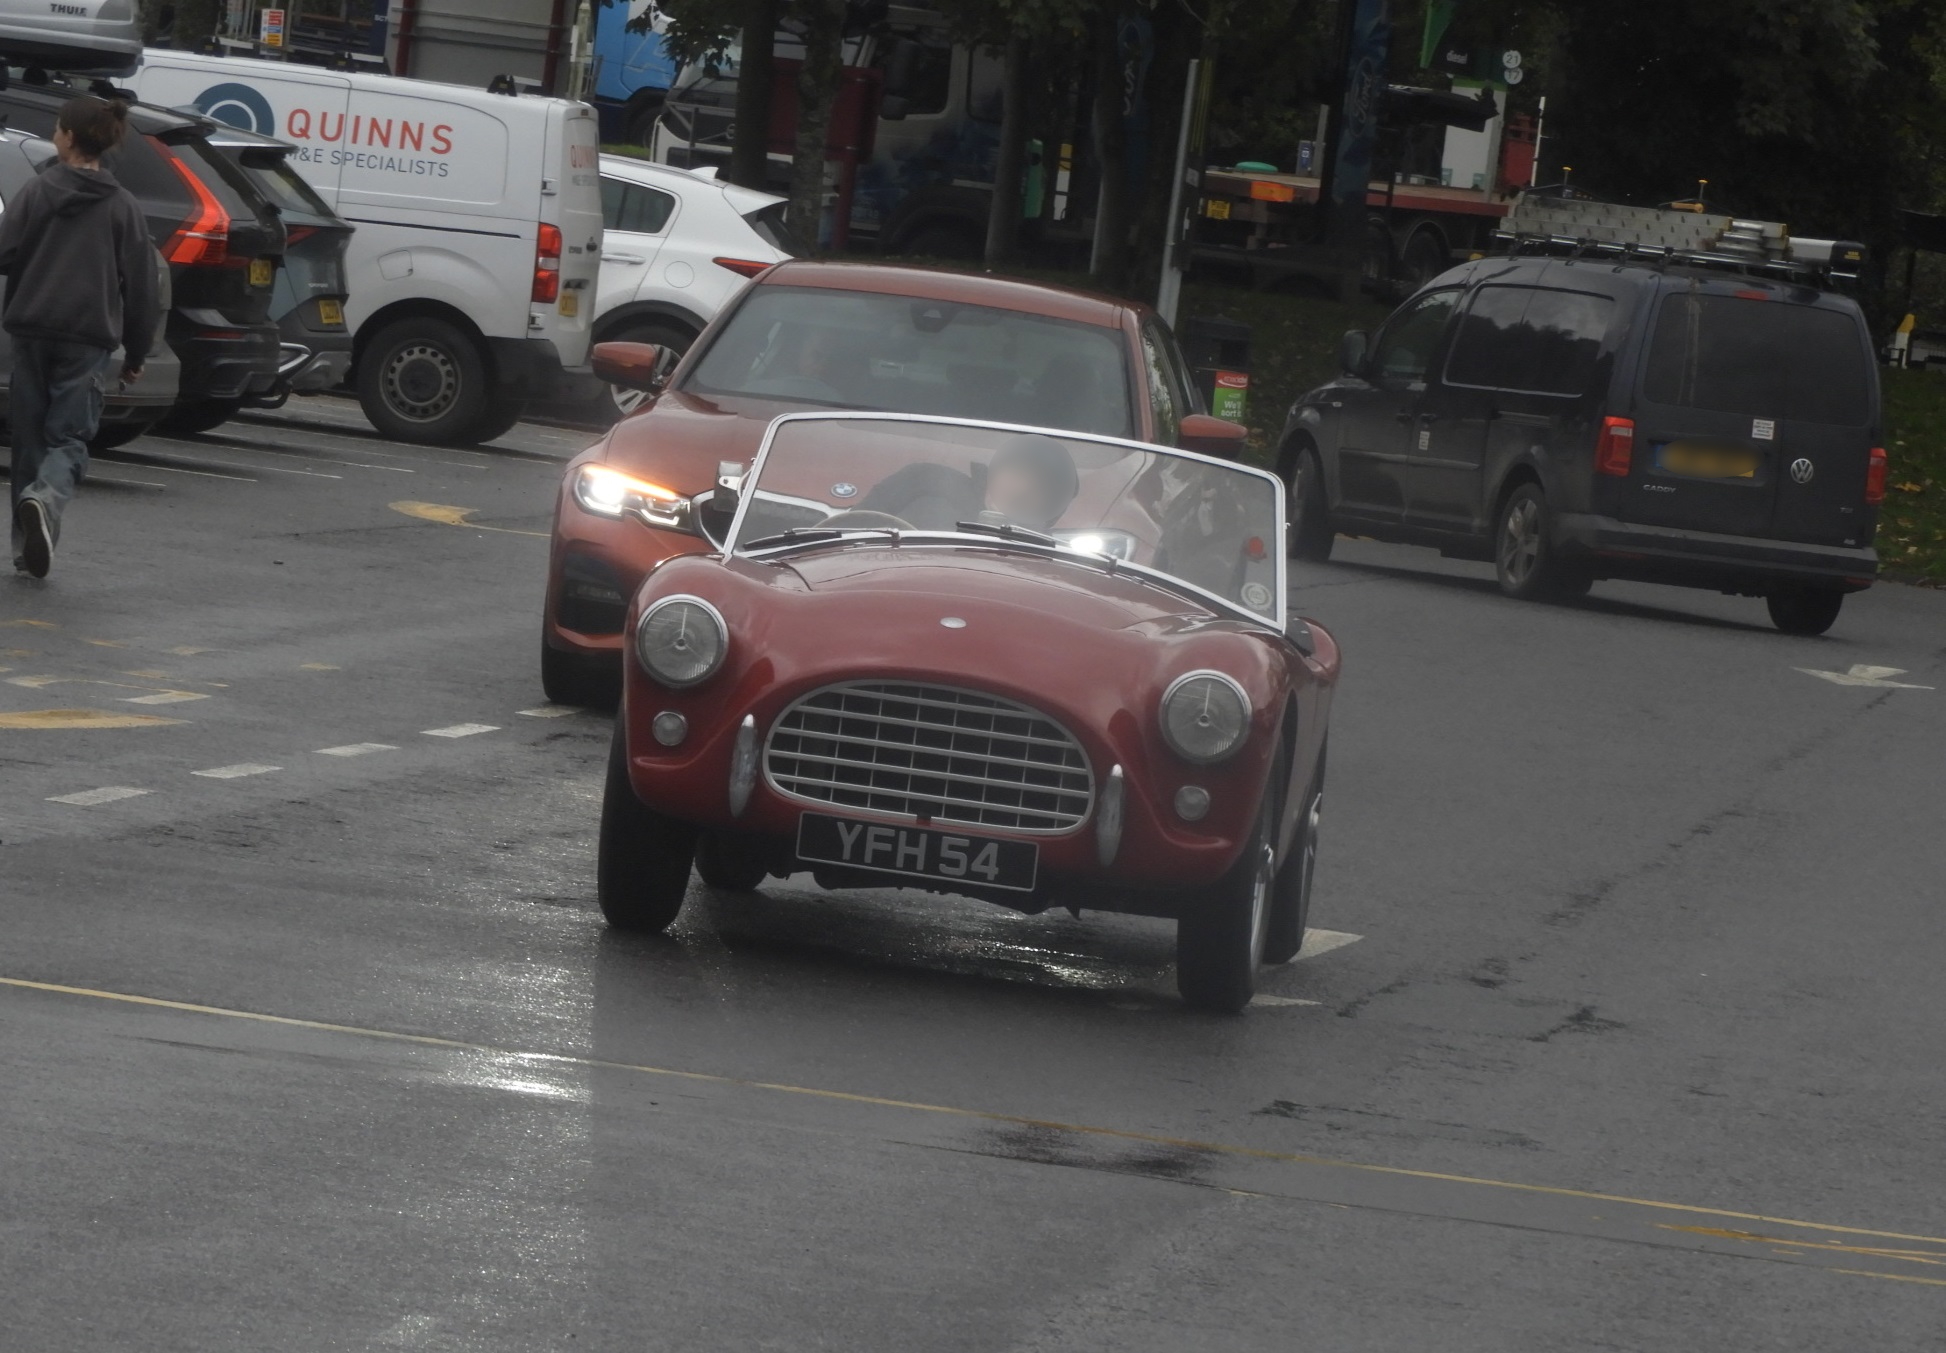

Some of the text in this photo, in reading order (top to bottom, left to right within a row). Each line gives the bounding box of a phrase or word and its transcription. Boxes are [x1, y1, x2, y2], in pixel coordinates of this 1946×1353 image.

[51, 3, 87, 17] THULE
[287, 109, 453, 155] QUINNS
[330, 150, 450, 178] SPECIALISTS
[1643, 484, 1677, 493] CADDY
[837, 821, 999, 881] YFH 54
